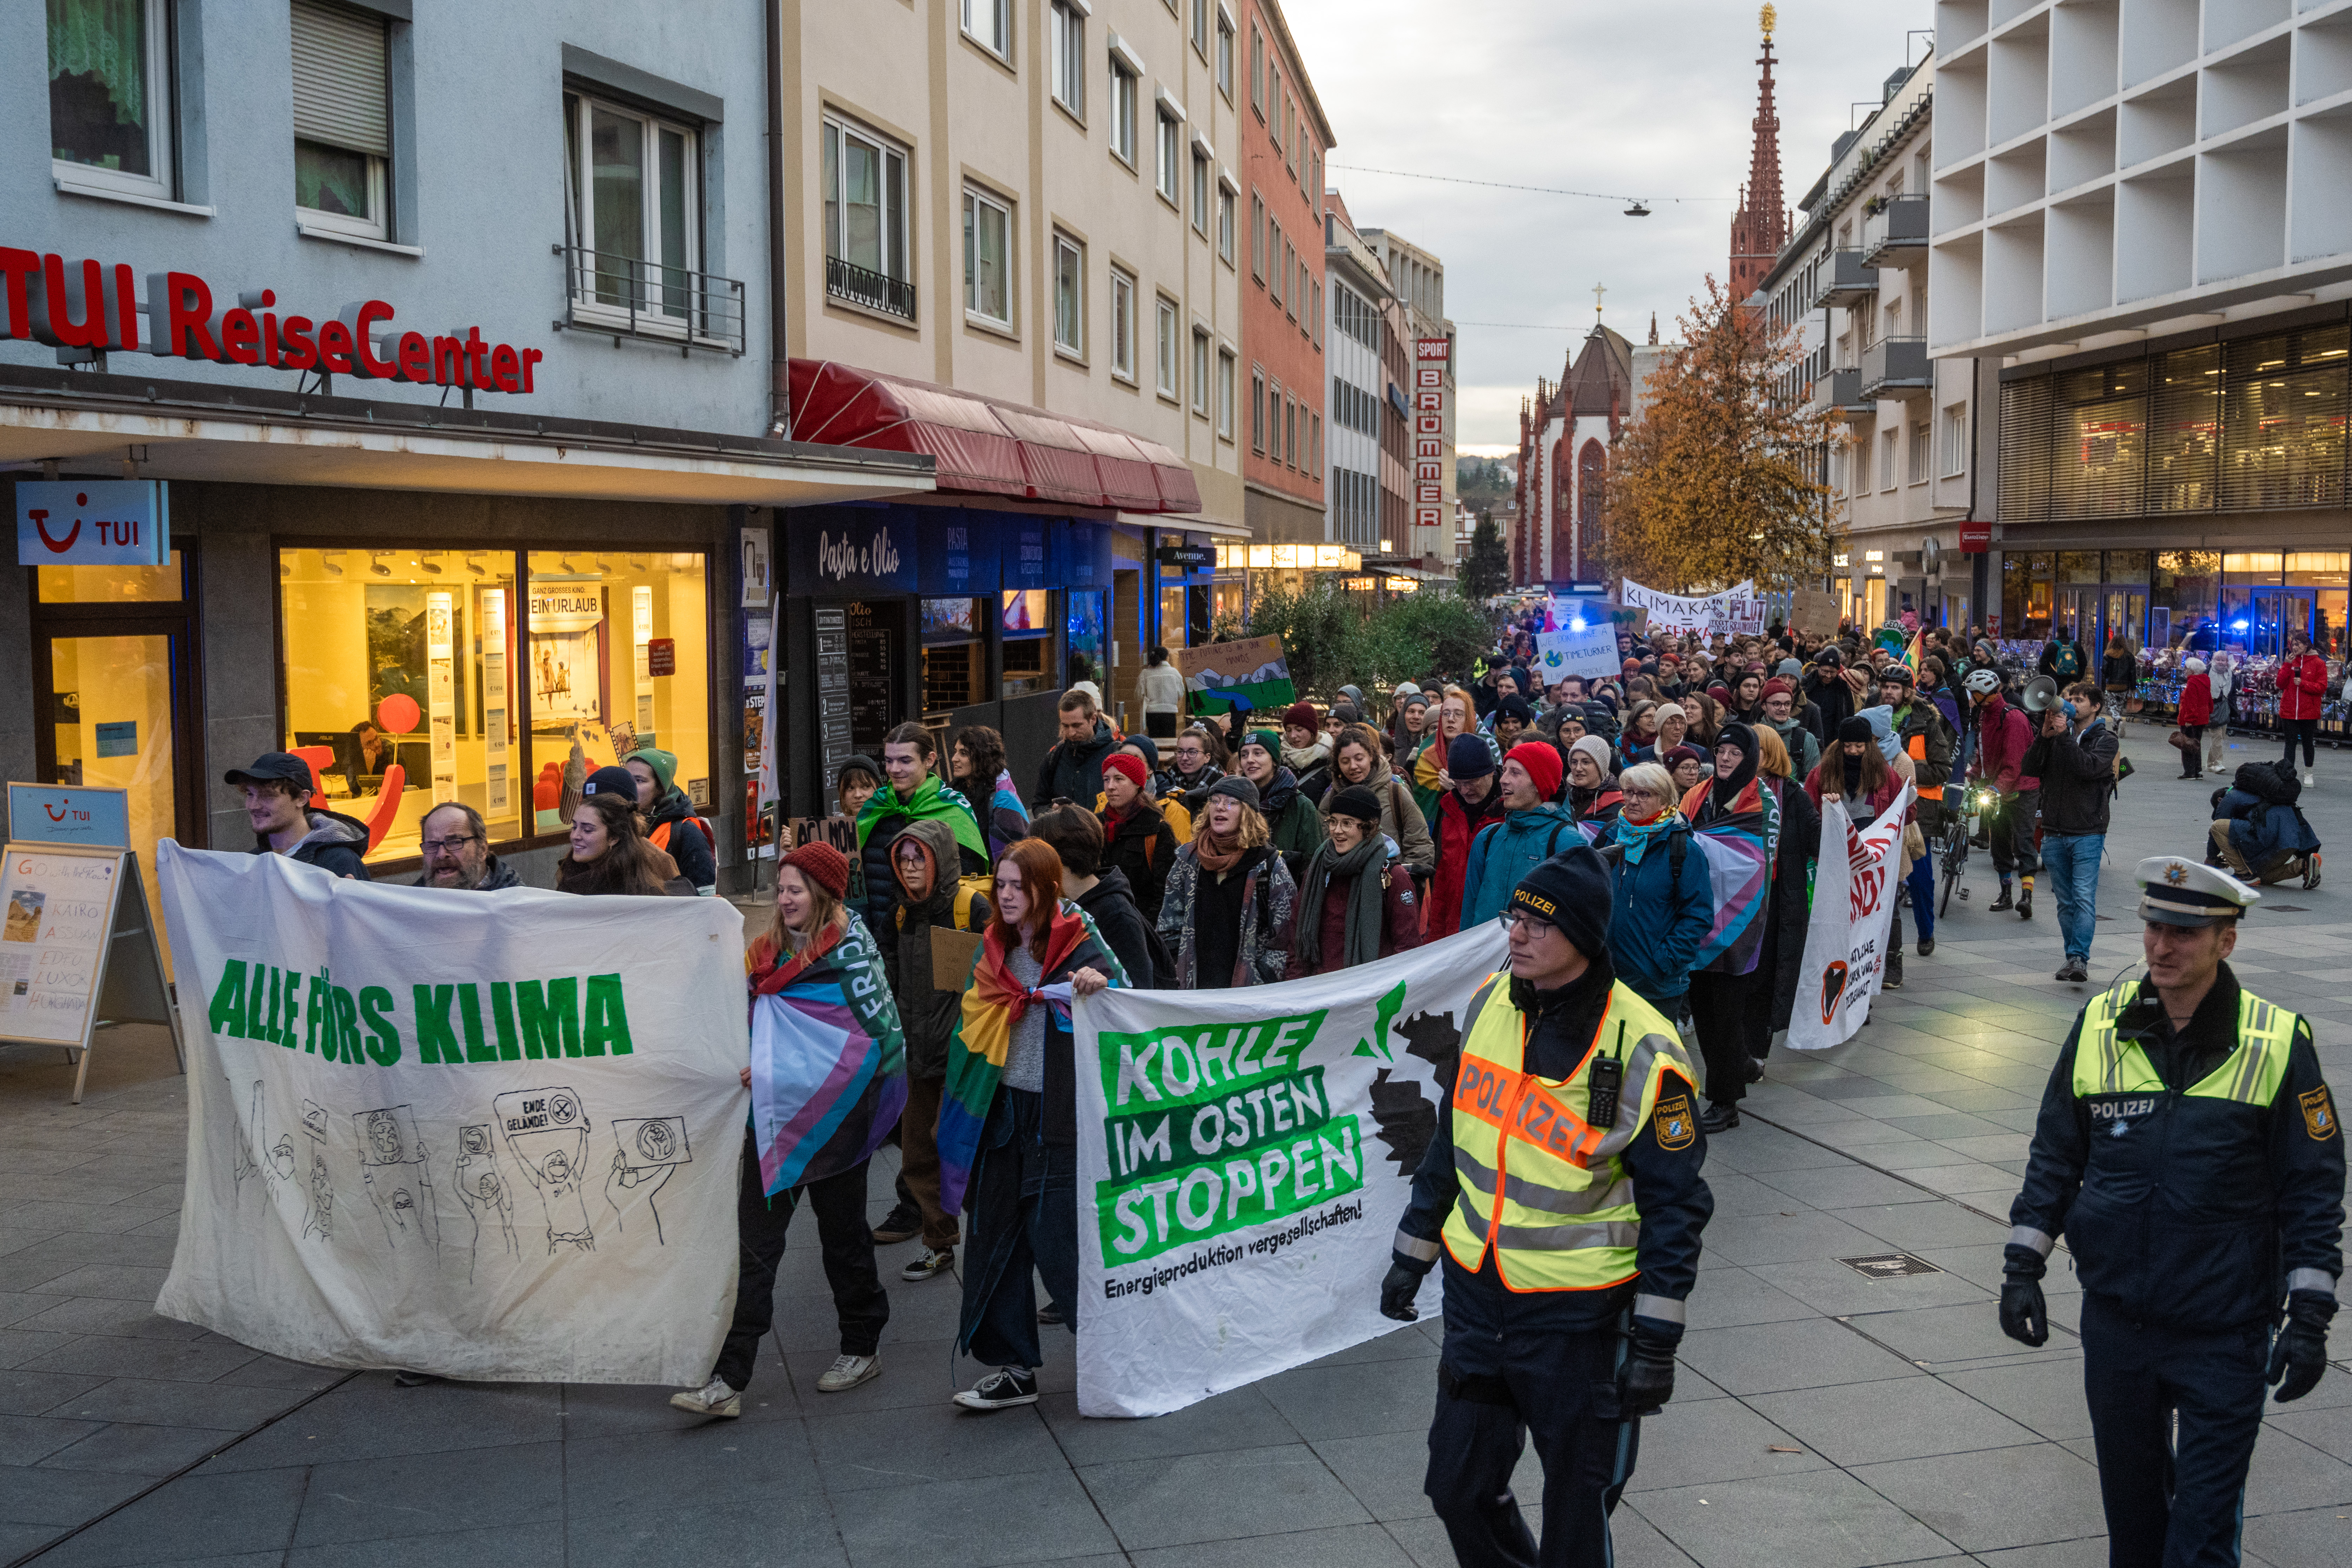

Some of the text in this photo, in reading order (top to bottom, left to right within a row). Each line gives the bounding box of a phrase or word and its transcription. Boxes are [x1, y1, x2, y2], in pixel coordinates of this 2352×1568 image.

[0, 246, 543, 394] TUI ReiseCenter
[1418, 342, 1447, 357] SPORT
[1419, 370, 1440, 525] BRÜMMER
[95, 520, 139, 546] TUI
[820, 526, 900, 581] Pasta e Olio
[529, 598, 597, 614] EIN URLAUB
[1729, 599, 1766, 622] FLUT
[1539, 637, 1553, 648] WE
[1601, 627, 1608, 636] A
[1563, 645, 1612, 660] TIMETURNER
[823, 698, 827, 715] 2
[824, 723, 828, 739] 3
[72, 810, 90, 821] TUI
[797, 816, 858, 854] ACT NOW
[52, 903, 98, 918] KAIRO
[1514, 889, 1556, 915] POLIZEI
[209, 958, 634, 1067] ALLE FÜRS KLIMA
[1116, 1020, 1309, 1106] KOHLE
[522, 1098, 546, 1114] ENDE
[1459, 1063, 1589, 1161] POLIZEI
[1656, 1100, 1686, 1115] POLIZEI
[2090, 1098, 2155, 1119] POLIZEI
[1114, 1074, 1324, 1177] IM OSTEN
[1112, 1126, 1359, 1254] STOPPEN
[1105, 1198, 1363, 1299] Energieproduktion vergesellschaften!
